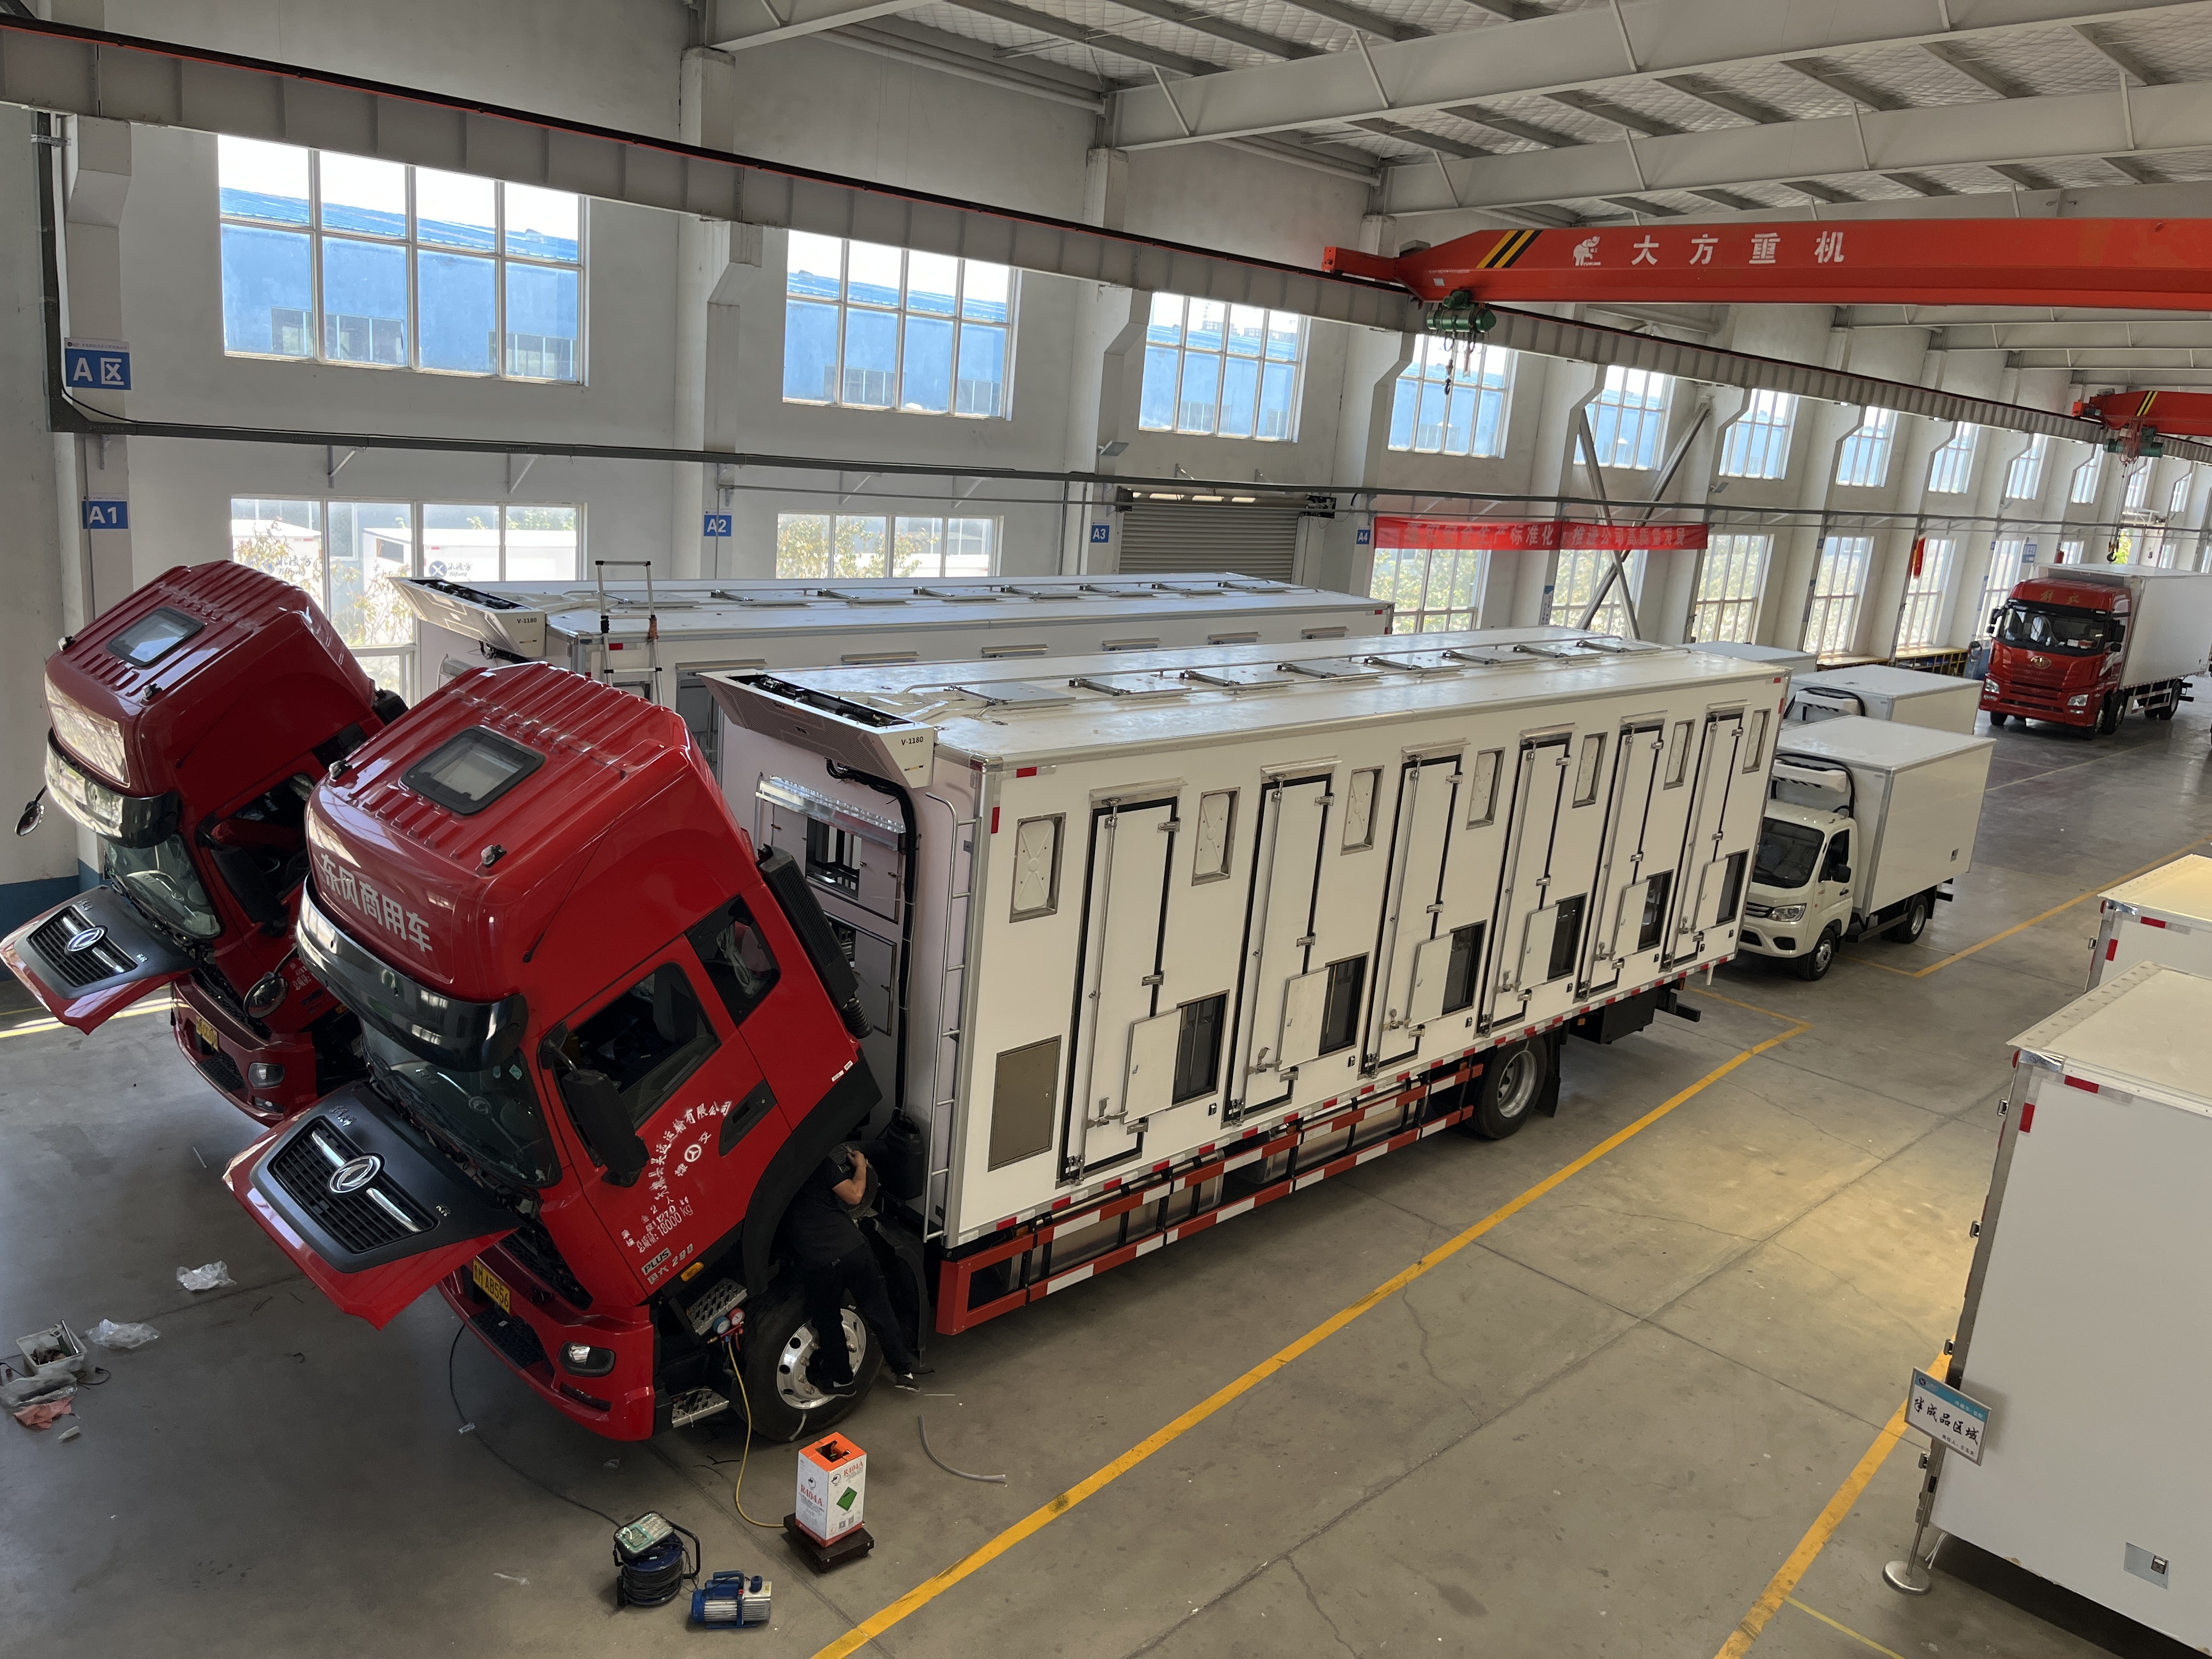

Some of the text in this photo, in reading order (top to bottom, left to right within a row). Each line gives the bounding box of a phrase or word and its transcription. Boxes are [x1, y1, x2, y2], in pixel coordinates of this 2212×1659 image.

[1631, 231, 1845, 266] 大方重机
[89, 506, 117, 523] A1
[707, 518, 726, 533] A2
[1092, 528, 1106, 539] A3
[1358, 532, 1368, 542] A4
[901, 736, 923, 746] V-1180
[321, 853, 433, 952] 东风商用车
[644, 1249, 669, 1273] PLUS
[1914, 1396, 1979, 1446] 半成品区域
[843, 1461, 864, 1476] R404A
[800, 1483, 823, 1507] R404A
